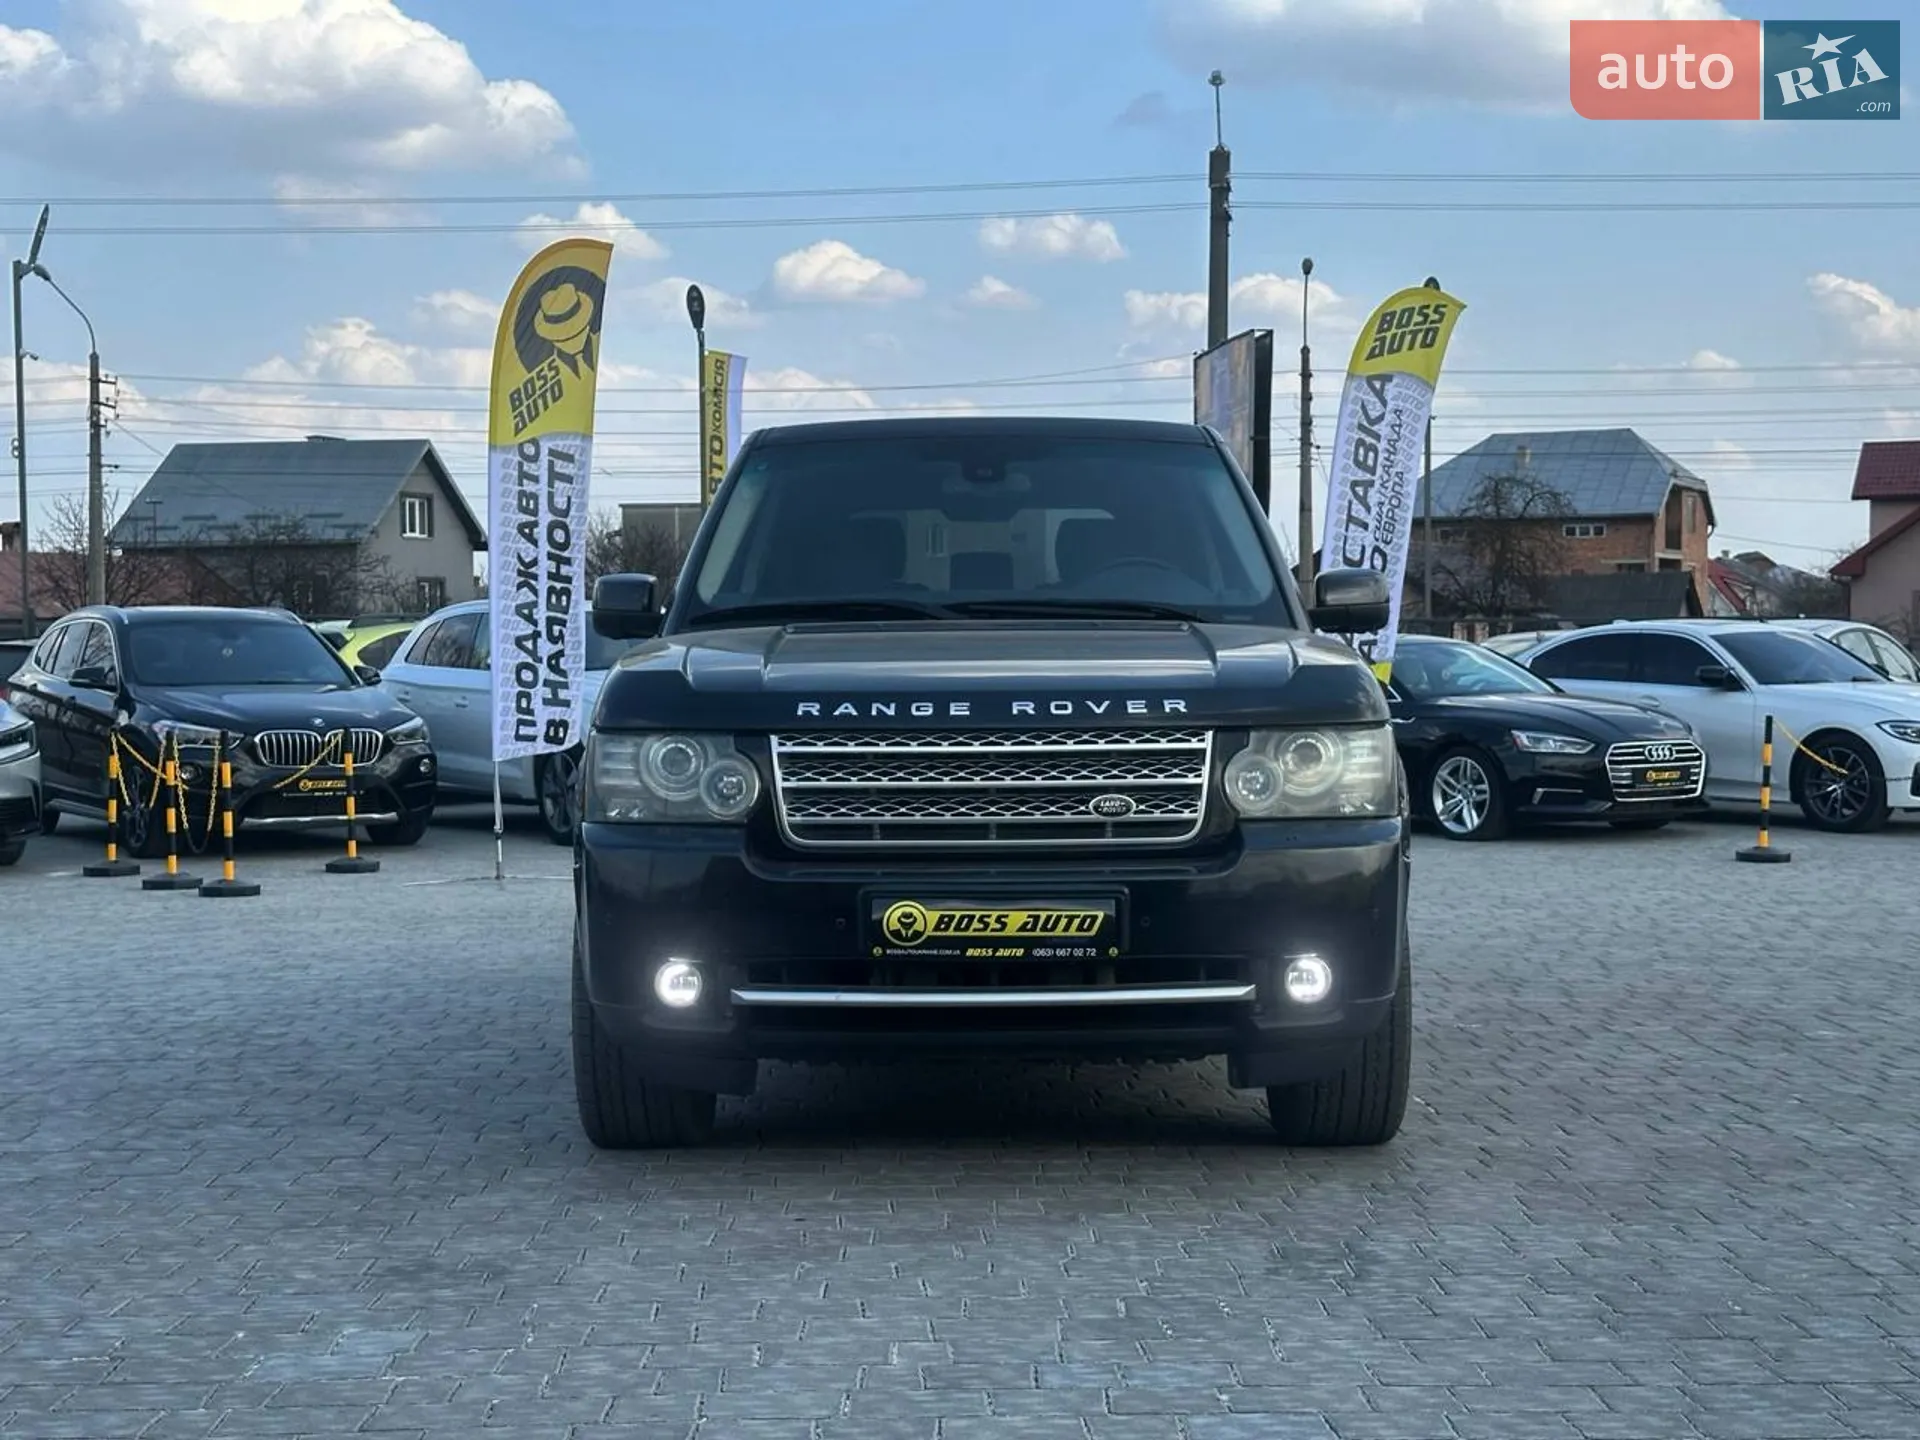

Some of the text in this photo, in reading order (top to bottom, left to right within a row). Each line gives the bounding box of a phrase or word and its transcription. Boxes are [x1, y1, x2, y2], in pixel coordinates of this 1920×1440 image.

[1376, 304, 1448, 335] BOSS
[1366, 326, 1440, 360] AUTO
[509, 359, 561, 413] BOSS
[513, 376, 564, 438] AUTO
[1342, 374, 1393, 568] СТАВКА
[514, 436, 543, 742] ПРОДАЖ АВТО
[542, 447, 575, 746] В НАЯВНОСТІ
[797, 699, 1189, 717] RANGE ROVER
[931, 913, 1099, 933] BOSS AUTO
[965, 948, 1025, 957] BOSS AUTO
[1072, 948, 1084, 957] 02
[1085, 948, 1097, 957] 72
